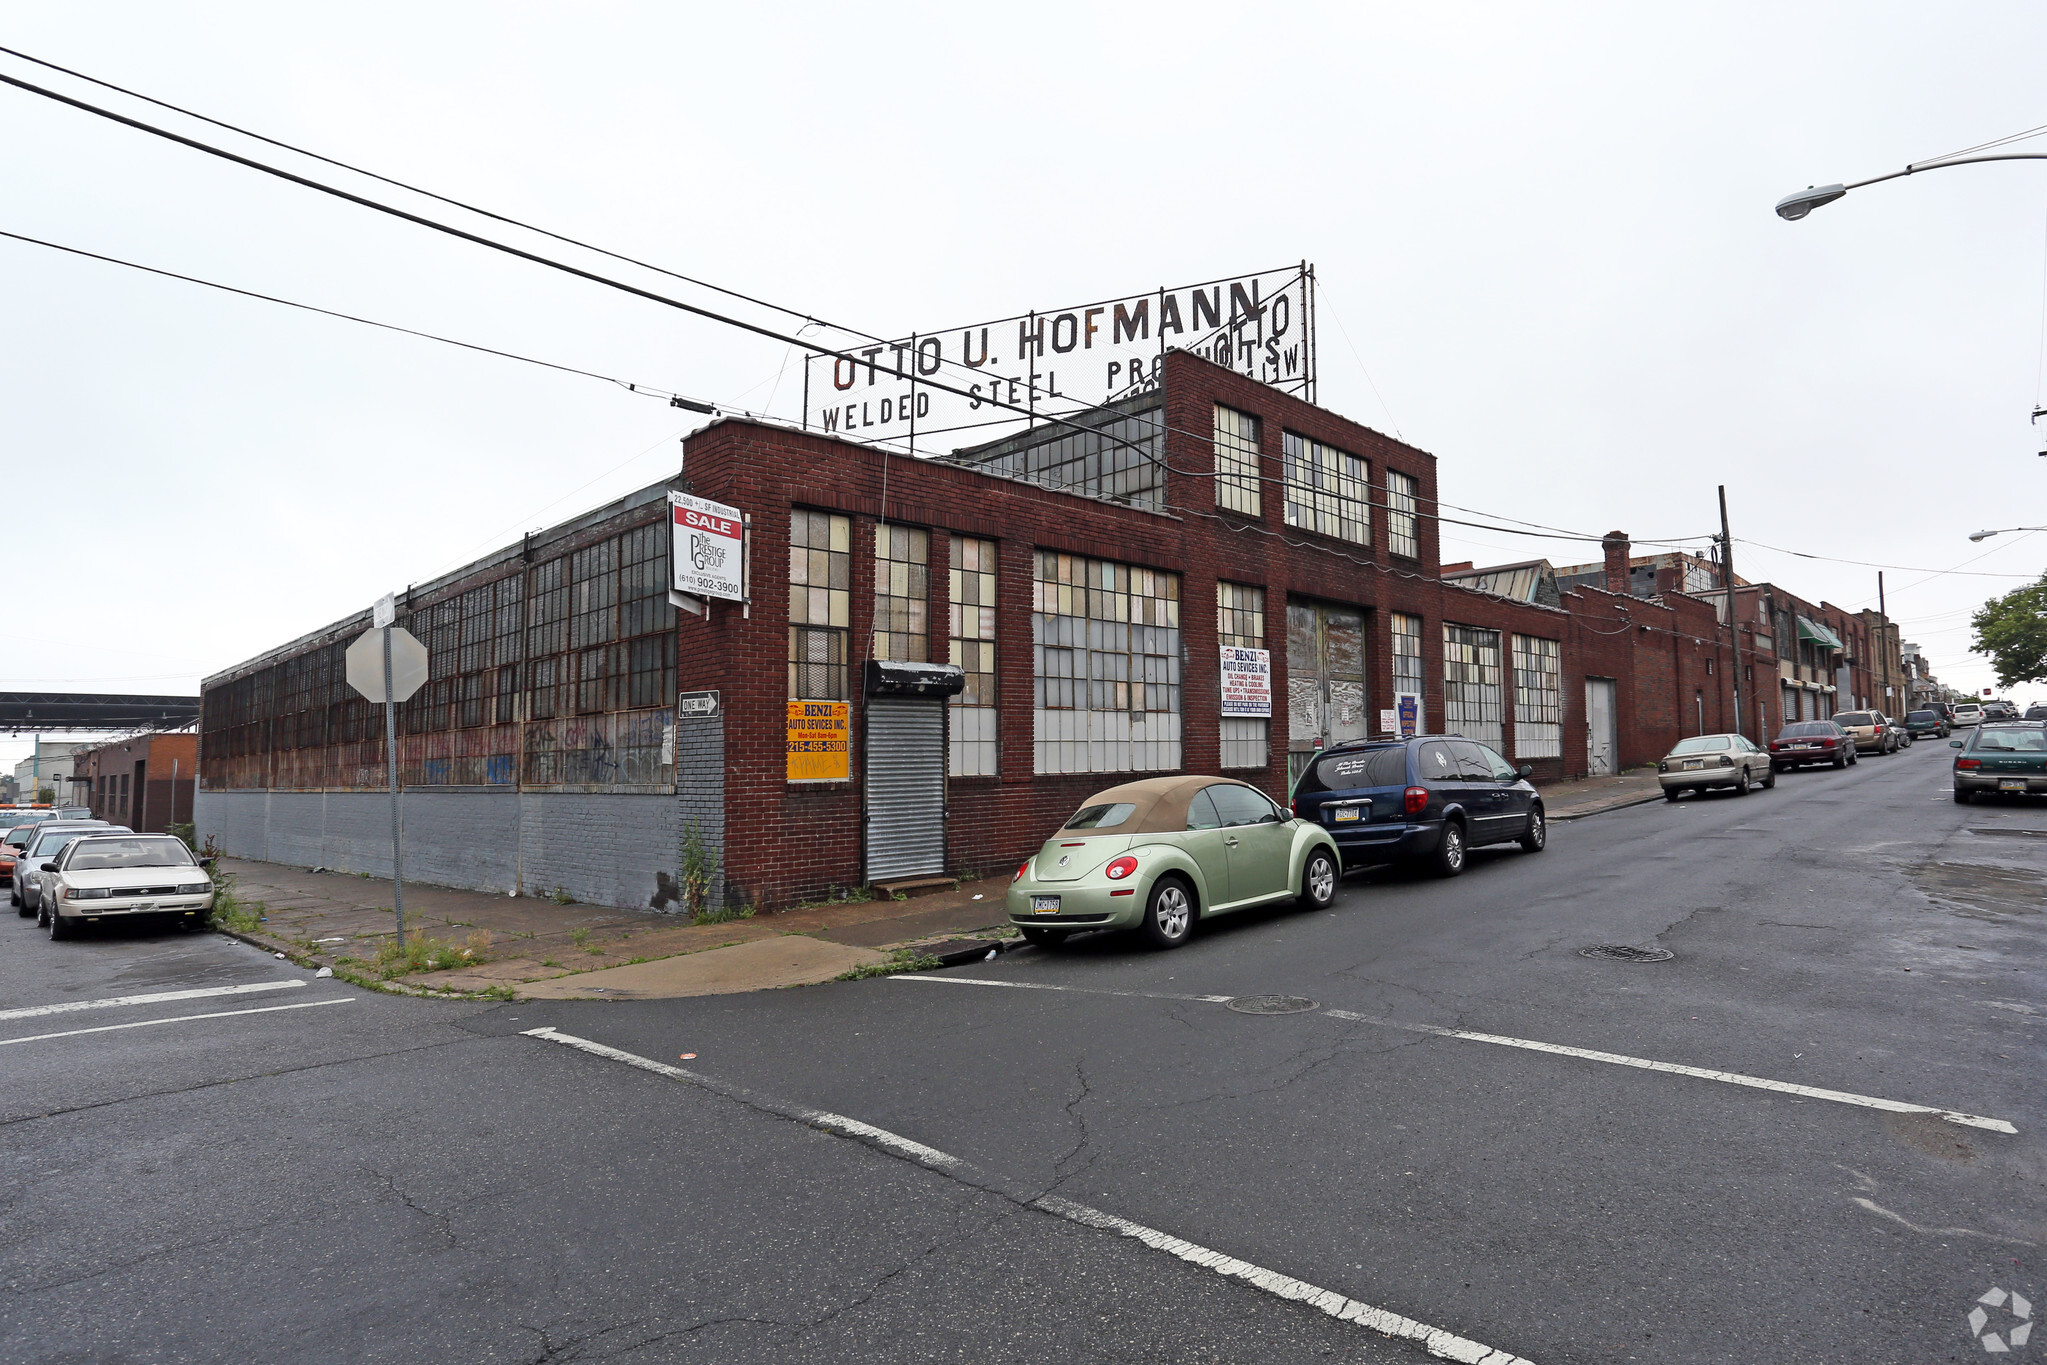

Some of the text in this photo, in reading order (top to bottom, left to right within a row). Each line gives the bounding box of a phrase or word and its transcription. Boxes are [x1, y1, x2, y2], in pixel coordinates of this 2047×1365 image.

[833, 279, 1260, 391] OTTO U. HOFMANN
[822, 392, 929, 433] WELDED
[969, 371, 1063, 410] STEEL
[674, 494, 693, 506] 22,500
[704, 502, 712, 510] SF
[712, 504, 740, 519] INDUSTRIAL
[685, 512, 732, 534] SALE
[698, 532, 710, 546] The
[679, 574, 738, 594] (610) 902-3900
[1235, 650, 1257, 661] BENZI
[1223, 661, 1268, 673] AUTO SEVICES INC.
[684, 699, 709, 710] ONE WAY
[804, 704, 832, 716] BENZI
[789, 719, 846, 730] AUTO SEVICES INC.
[789, 742, 846, 752] 215-455-5300
